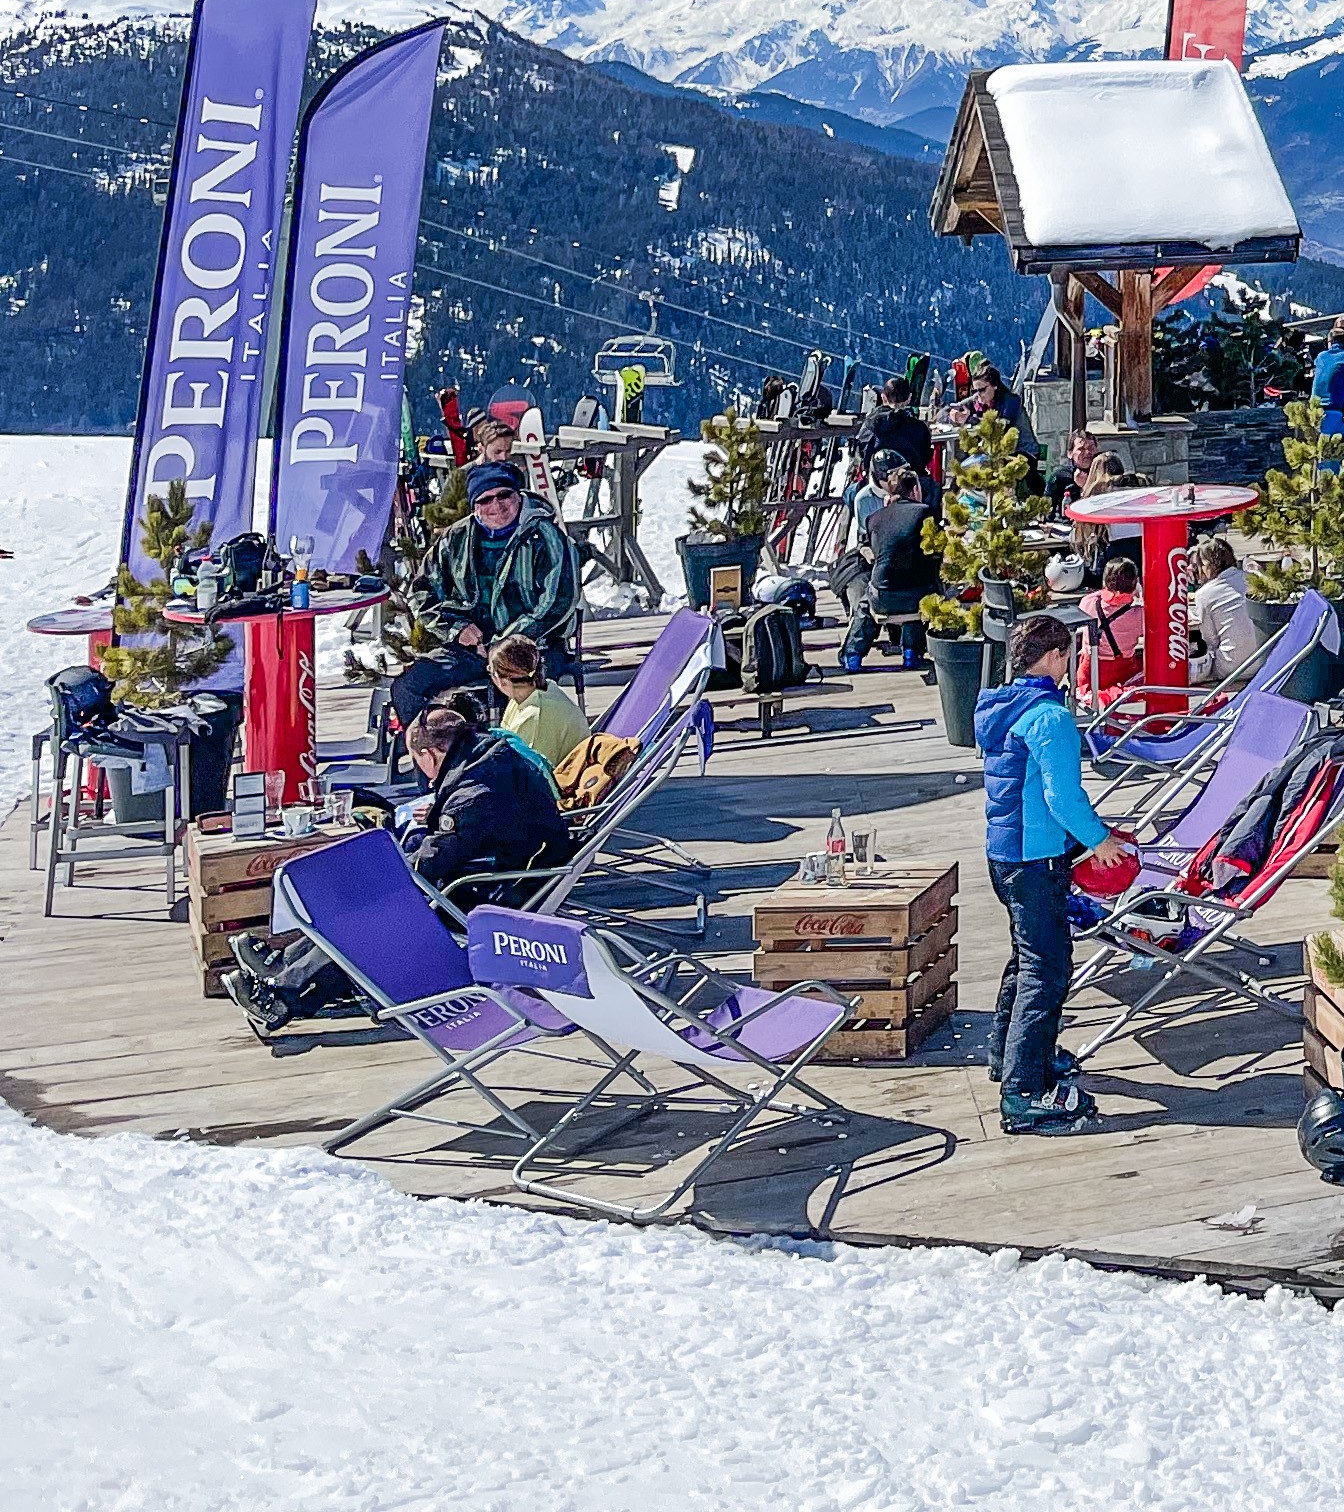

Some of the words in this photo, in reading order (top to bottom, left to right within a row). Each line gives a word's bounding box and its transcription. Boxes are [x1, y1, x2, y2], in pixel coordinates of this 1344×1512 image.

[144, 96, 263, 502] PERONI
[239, 229, 273, 381] ITALIA
[290, 181, 383, 466] PERONI
[380, 270, 409, 381] ITALIA
[492, 931, 568, 965] PERONI
[519, 959, 548, 972] ITALIA
[409, 993, 488, 1028] ERON
[446, 1011, 483, 1031] ITALIA
